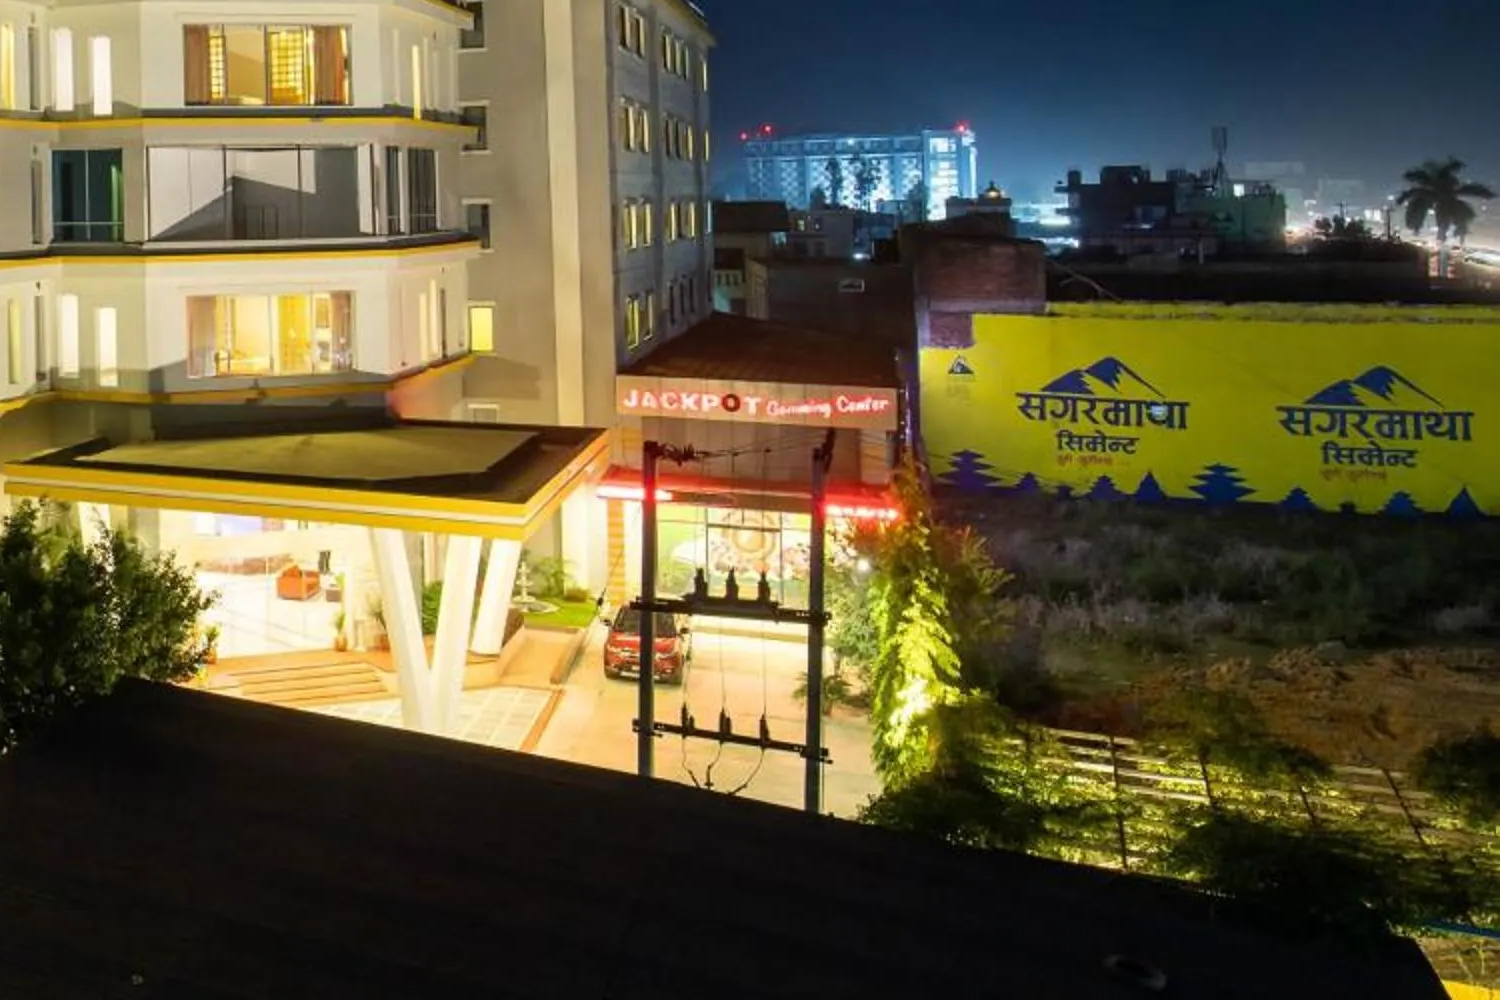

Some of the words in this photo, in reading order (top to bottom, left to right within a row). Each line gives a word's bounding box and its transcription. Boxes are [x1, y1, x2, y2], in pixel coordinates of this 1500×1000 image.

[623, 388, 762, 415] JACKPOT
[837, 395, 889, 414] Center
[1015, 391, 1191, 430] सगरमाथा
[1275, 405, 1475, 441] सगरमाथा
[1056, 429, 1141, 455] सिमेन्ट
[1320, 440, 1420, 468] सिमेन्ट
